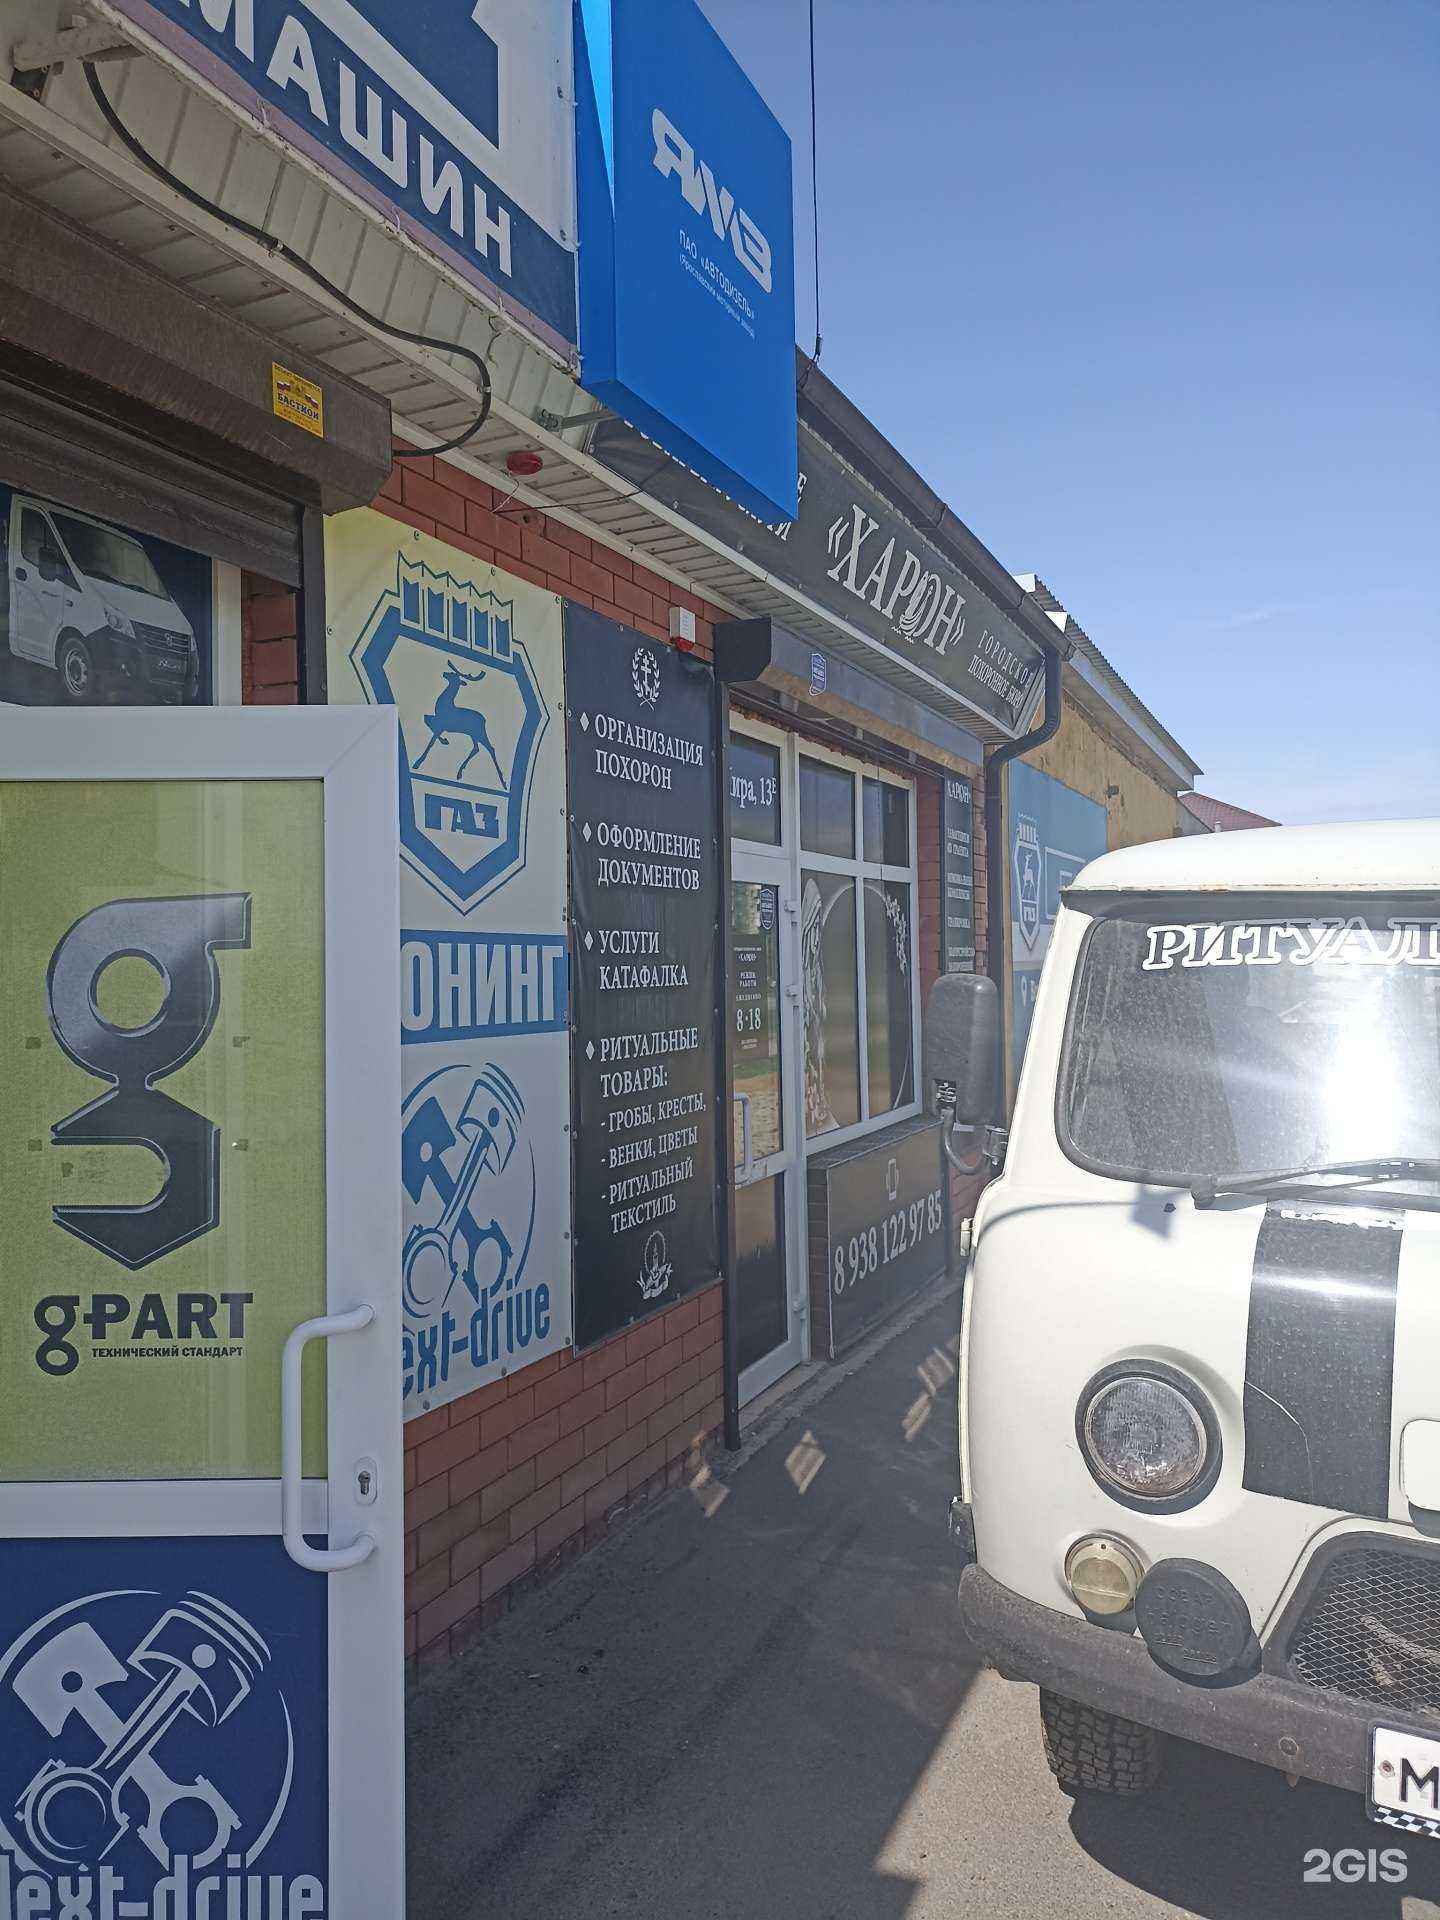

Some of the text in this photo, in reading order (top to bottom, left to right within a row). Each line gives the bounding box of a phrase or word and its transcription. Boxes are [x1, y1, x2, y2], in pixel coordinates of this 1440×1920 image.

[679, 228, 697, 260] ПАО
[594, 713, 705, 766] ОРГАНИЗАЦИЯ
[595, 748, 673, 790] ПОХОРОН
[424, 793, 500, 839] ГАЗ
[597, 822, 701, 860] ОФОРМЛЕНИЕ
[598, 857, 700, 890] ДОКУМЕНТОВ
[598, 930, 660, 954] УСЛУГИ
[599, 964, 689, 990] КАТАФАЛКА
[600, 1027, 699, 1062] РИТУАЛЬНЫЕ
[600, 1065, 668, 1098] ТОВАРЫ:
[609, 1092, 707, 1133] ГРОБЫ, КРЕСТЫ,
[609, 1126, 699, 1169] ВЕНКИ, ЦВЕТЫ
[609, 1157, 693, 1205] РИТУАЛЬНЫЙ
[611, 1193, 677, 1234] ТЕКСТИЛЬ
[834, 1188, 943, 1295] 8 938 122 97 85
[92, 1345, 243, 1359] ТЕХНИЧЕСКИЙ СТАНДАРТ
[1399, 1757, 1440, 1810] М
